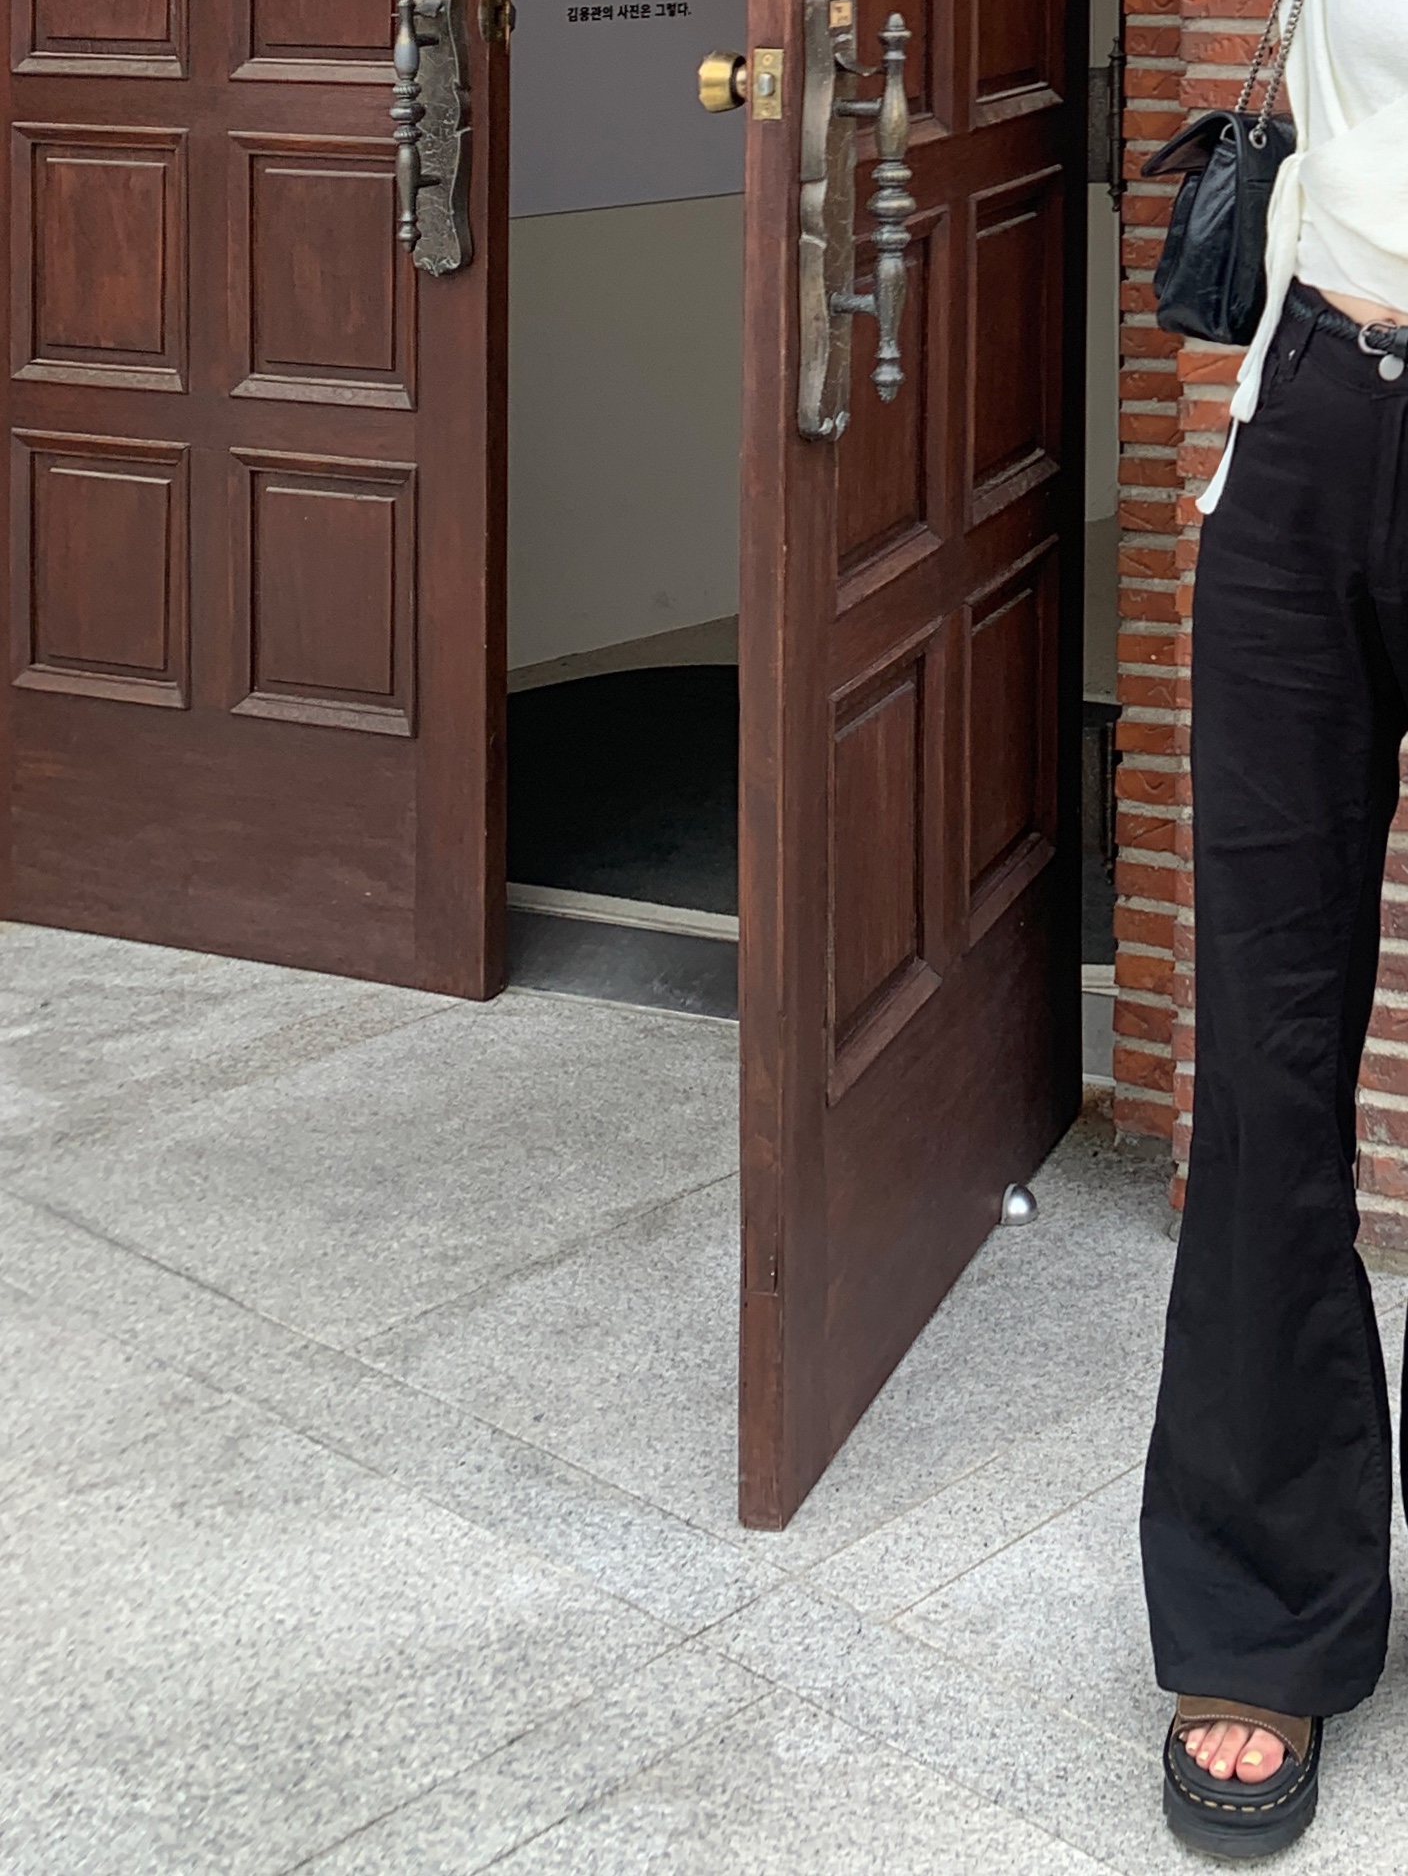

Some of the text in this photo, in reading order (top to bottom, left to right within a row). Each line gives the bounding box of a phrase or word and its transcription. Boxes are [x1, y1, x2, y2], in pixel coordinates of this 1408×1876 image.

[567, 2, 692, 22] 김용관의 사진은 그렇다.
